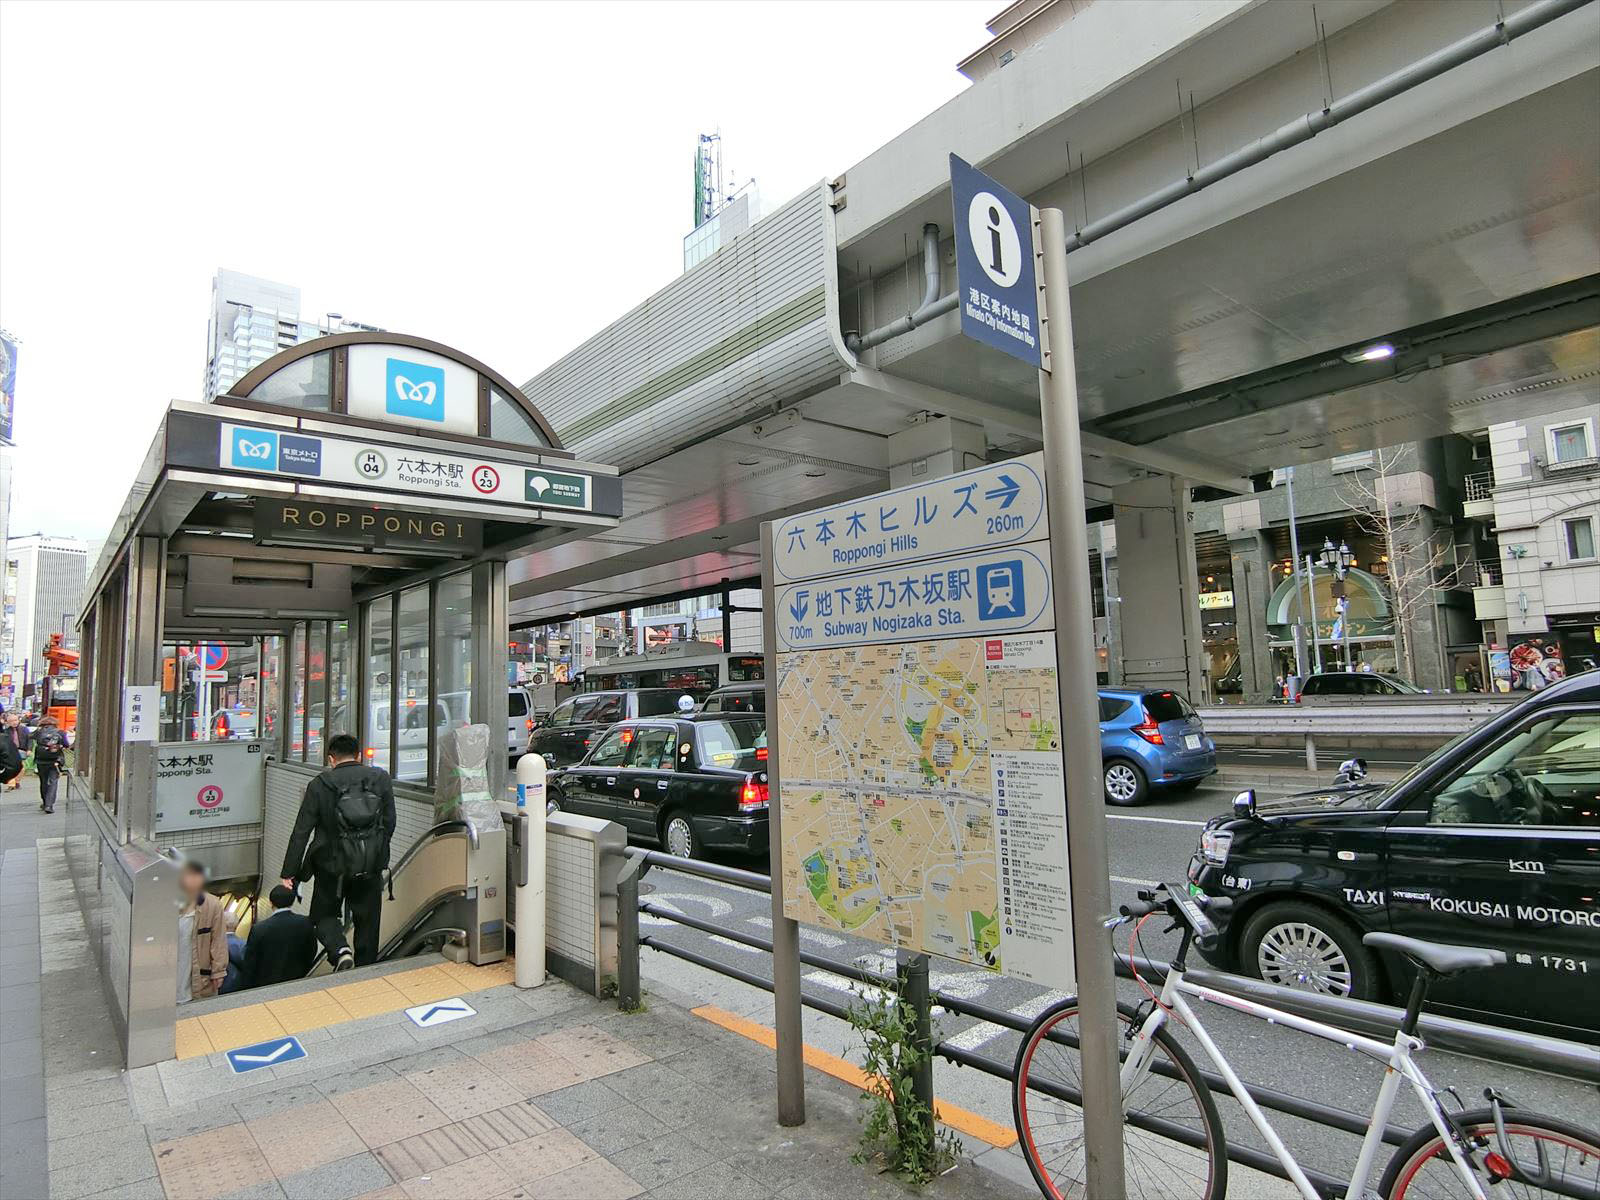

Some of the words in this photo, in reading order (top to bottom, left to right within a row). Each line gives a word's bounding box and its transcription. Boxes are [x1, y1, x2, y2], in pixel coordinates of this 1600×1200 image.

[969, 287, 1030, 330] 港区案内地図
[966, 302, 985, 323] Minato
[985, 312, 996, 331] City
[996, 317, 1024, 341] Information
[1024, 330, 1035, 349] Map
[363, 463, 379, 474] 04
[367, 454, 376, 463] H
[397, 457, 464, 479] 六本木駅
[399, 473, 443, 487] Roppongi
[445, 479, 462, 489] Sta.
[479, 479, 493, 488] 23
[483, 470, 489, 478] E
[282, 507, 463, 538] ROPPONGI
[787, 482, 978, 553] 六本木ヒルズ
[987, 514, 1024, 535] 260m
[832, 540, 887, 563] Roppongi
[890, 534, 918, 552] Hills
[815, 568, 972, 618] 地下鉄乃木坂駅
[789, 626, 813, 640] 700m
[824, 618, 869, 638] Subway
[873, 612, 932, 633] Nogizaka
[938, 609, 965, 626] Sta.
[131, 694, 142, 733] 右側通行
[195, 766, 212, 775] Sta.
[1509, 859, 1545, 872] km
[1342, 888, 1385, 905] TAXI
[1430, 896, 1510, 918] KOKUSAI
[1540, 956, 1587, 973] 1731
